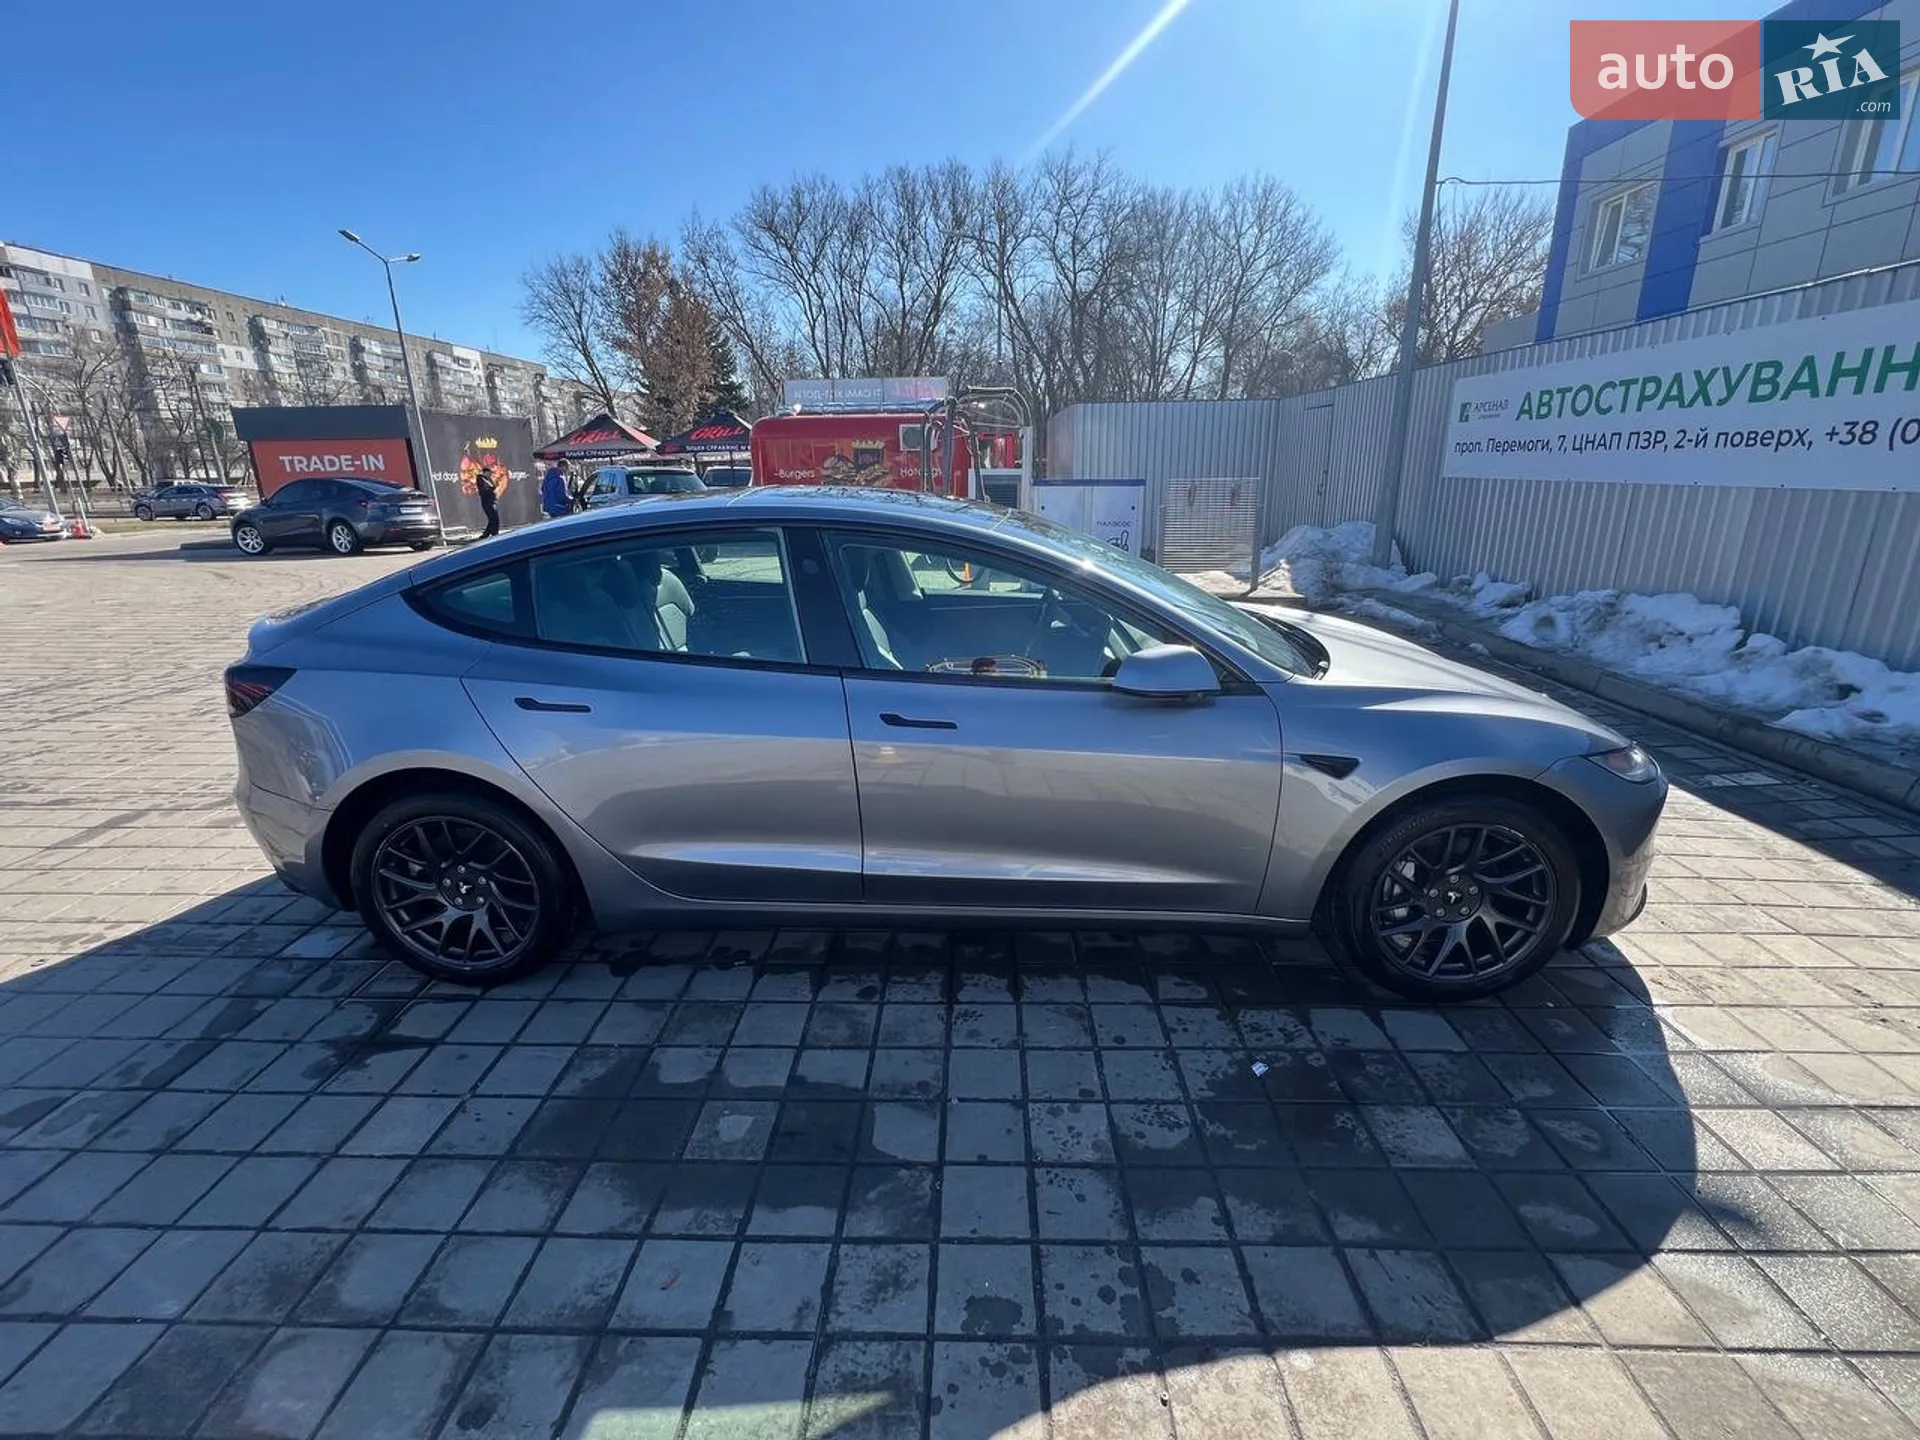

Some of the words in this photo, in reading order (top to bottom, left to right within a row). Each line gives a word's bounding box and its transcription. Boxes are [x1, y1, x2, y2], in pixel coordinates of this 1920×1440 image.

[1515, 341, 1920, 421] АВТОСТРАХУВАНН
[1454, 441, 1483, 455] проп.
[1486, 438, 1552, 455] Перемоги,
[1557, 435, 1567, 454] 7,
[1572, 432, 1622, 453] ЦНАП
[1627, 430, 1668, 452] ПЗР,
[1673, 427, 1708, 449] 2-й
[1715, 427, 1813, 452] поверх,
[1825, 420, 1879, 445] +38
[279, 454, 385, 472] TRADE-IN
